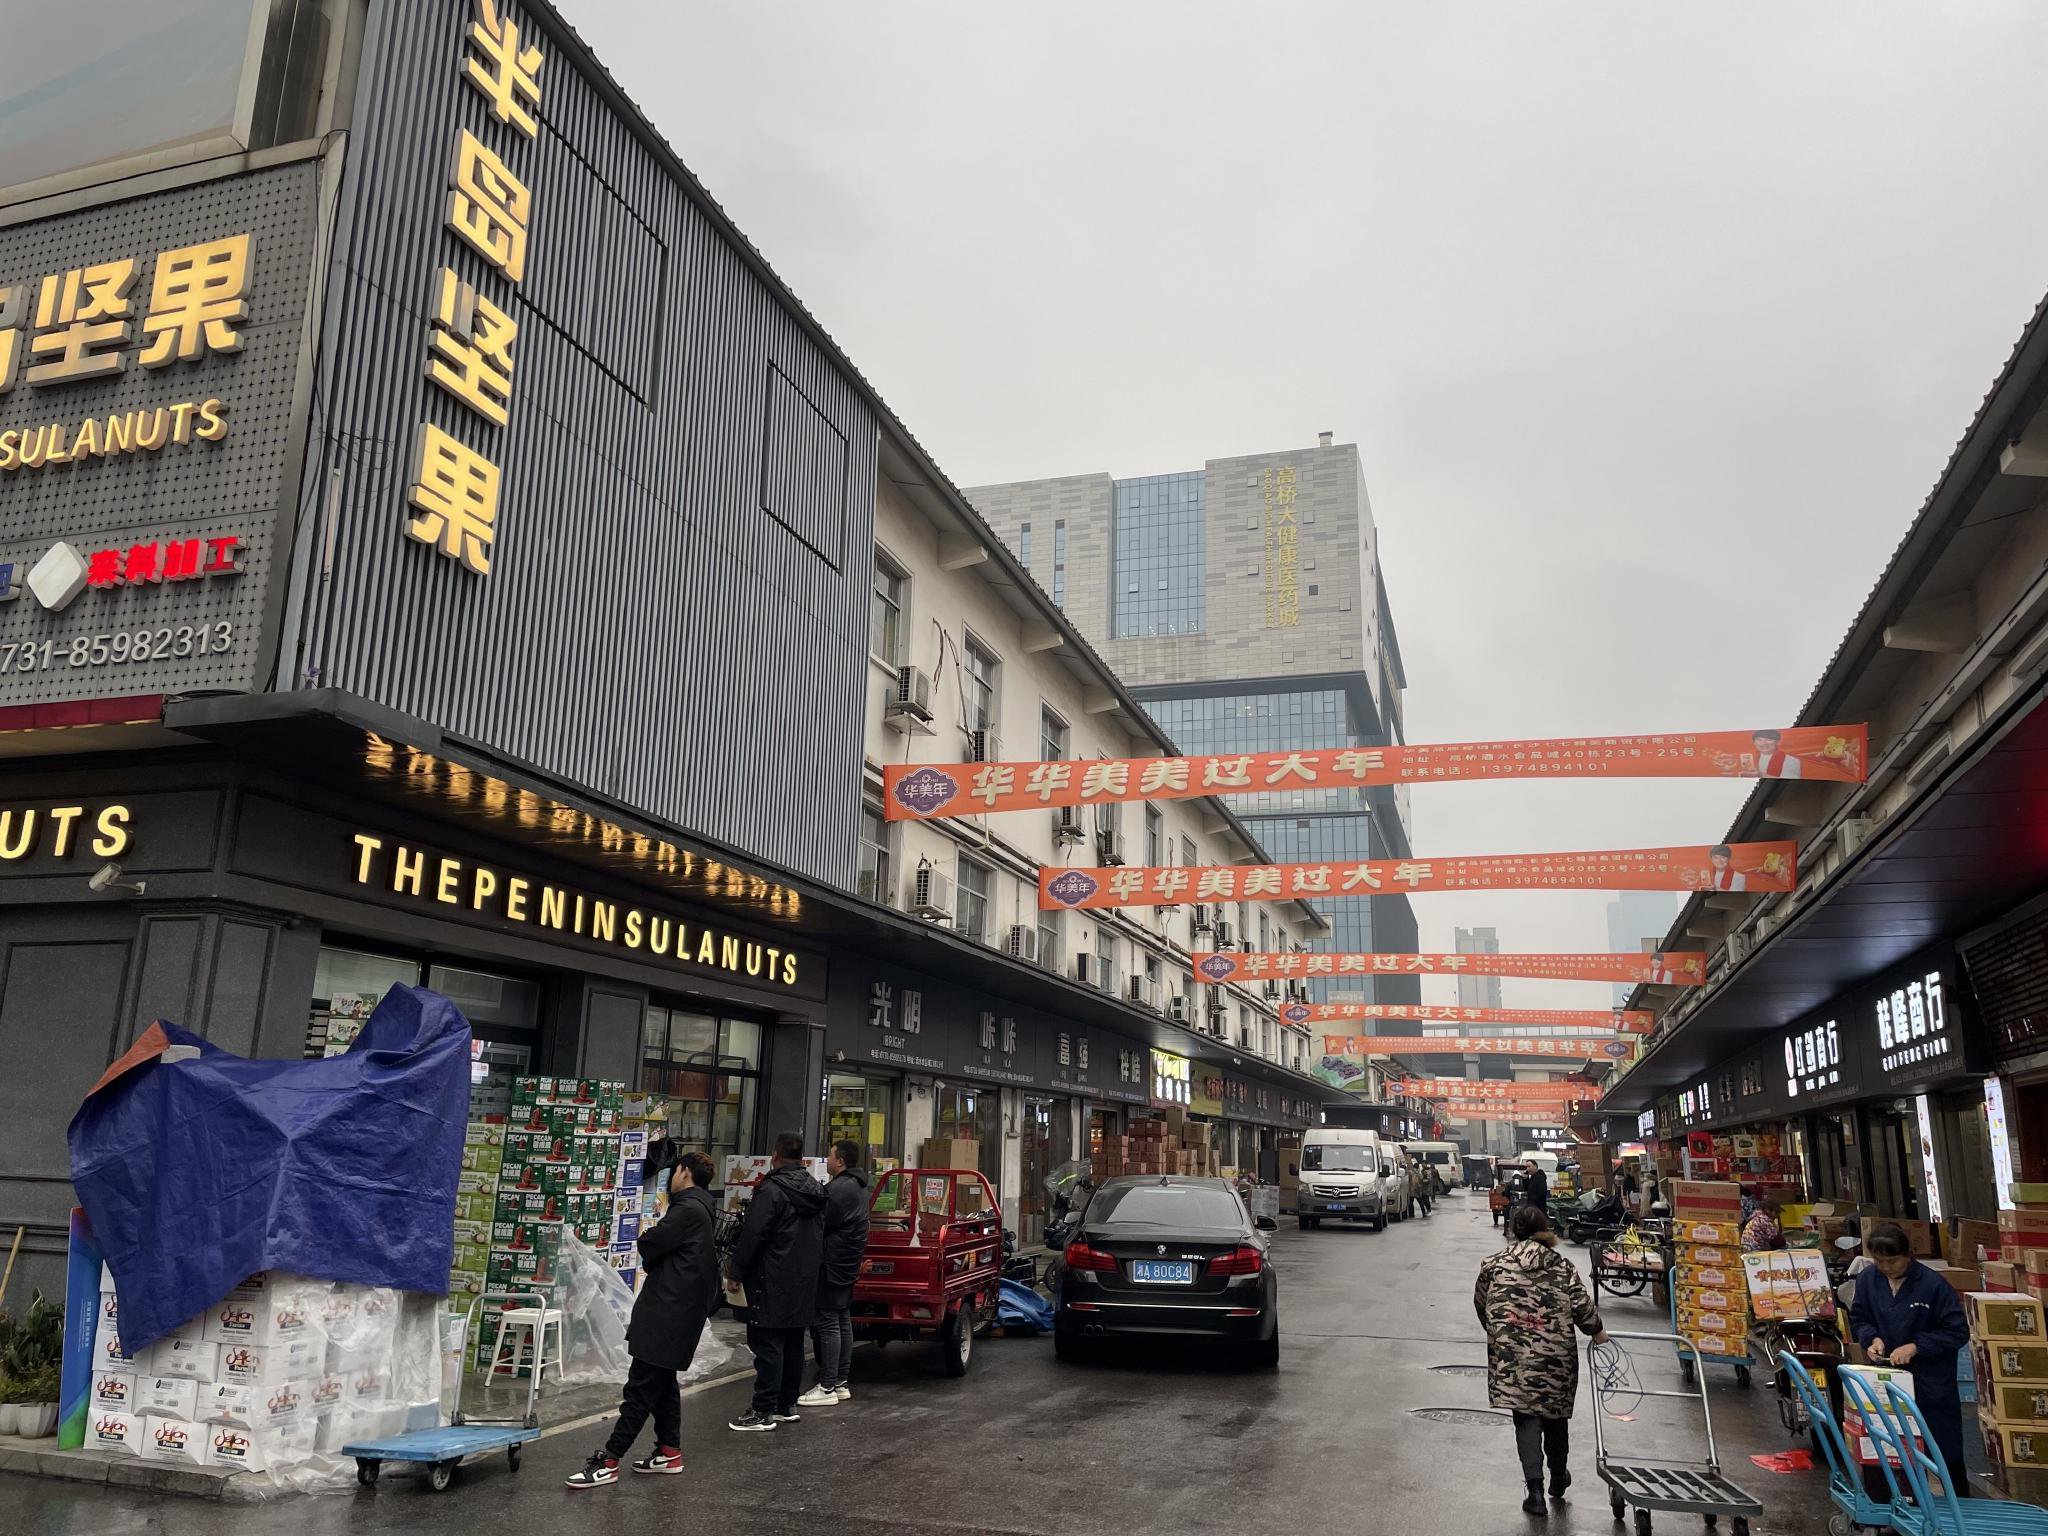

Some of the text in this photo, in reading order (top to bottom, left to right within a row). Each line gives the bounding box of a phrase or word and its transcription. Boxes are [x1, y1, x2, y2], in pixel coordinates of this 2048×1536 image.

[403, 0, 544, 576] 半岛坚果
[0, 398, 228, 470] SULANUTS
[88, 537, 246, 589] 来料加工
[1276, 466, 1299, 628] 高桥大健康医药城
[904, 782, 948, 798] 华美年
[971, 750, 1384, 805] 华华美美过大年
[1055, 882, 1090, 894] 华美年
[1109, 862, 1434, 901] 华华美美过大年
[353, 834, 798, 985] THEPENINSULANUTS
[1244, 955, 1468, 976] 华华美美过大年
[868, 982, 921, 1034] 光明
[1317, 1005, 1484, 1019] 华华美美过大年
[1154, 1265, 1189, 1279] 80C84
